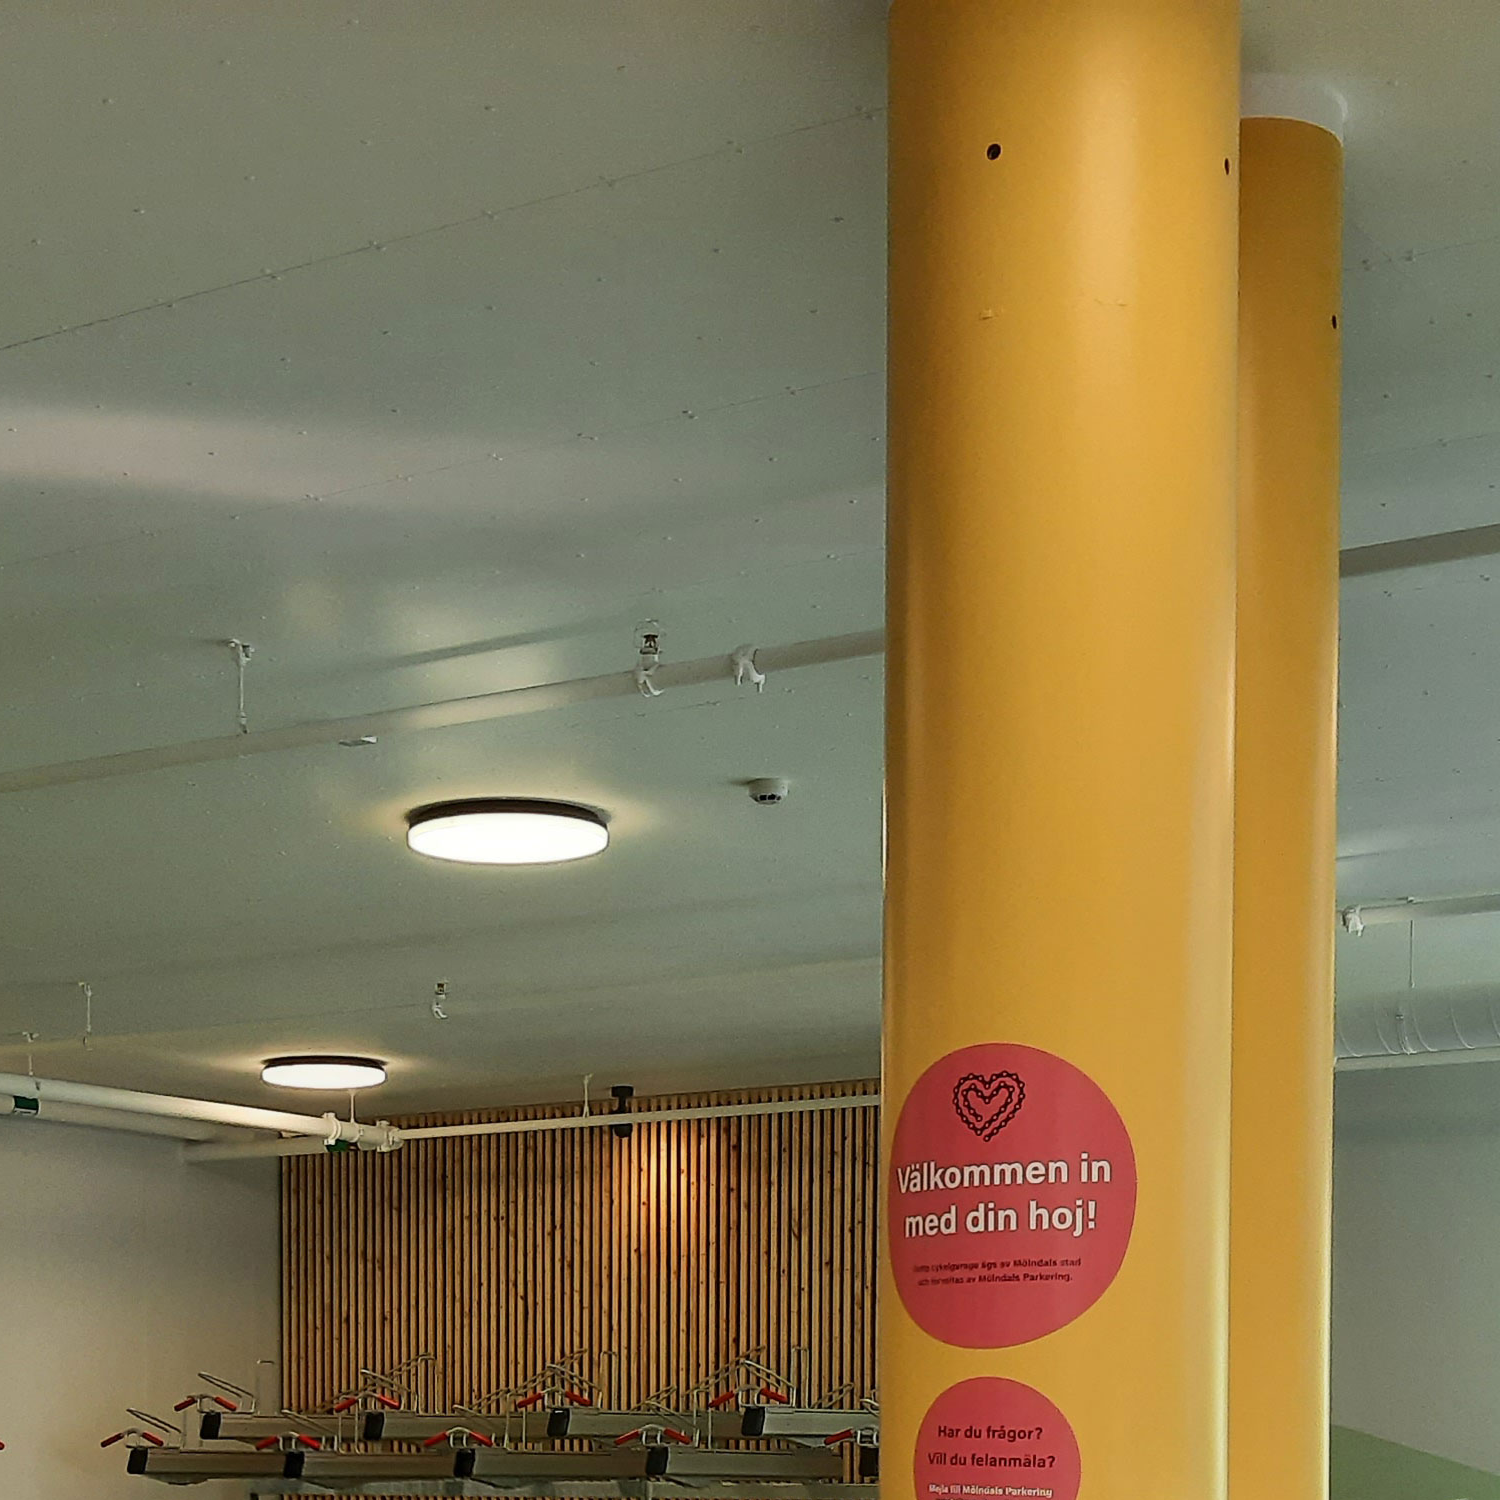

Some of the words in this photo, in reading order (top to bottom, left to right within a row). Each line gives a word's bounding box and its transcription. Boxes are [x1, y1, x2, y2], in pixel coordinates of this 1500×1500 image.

[897, 1160, 1068, 1194] Välkommen
[1080, 1152, 1111, 1183] in
[904, 1204, 957, 1238] med
[965, 1202, 1017, 1234] din
[1029, 1199, 1097, 1238] hoj!
[938, 1425, 961, 1438] Har
[964, 1425, 982, 1439] du
[986, 1425, 1043, 1442] frågor?
[927, 1453, 946, 1465] Vill
[950, 1453, 967, 1466] du
[971, 1453, 1056, 1469] felanmäla?
[962, 1485, 1003, 1495] Mölndals
[1005, 1486, 1053, 1498] Parkering
